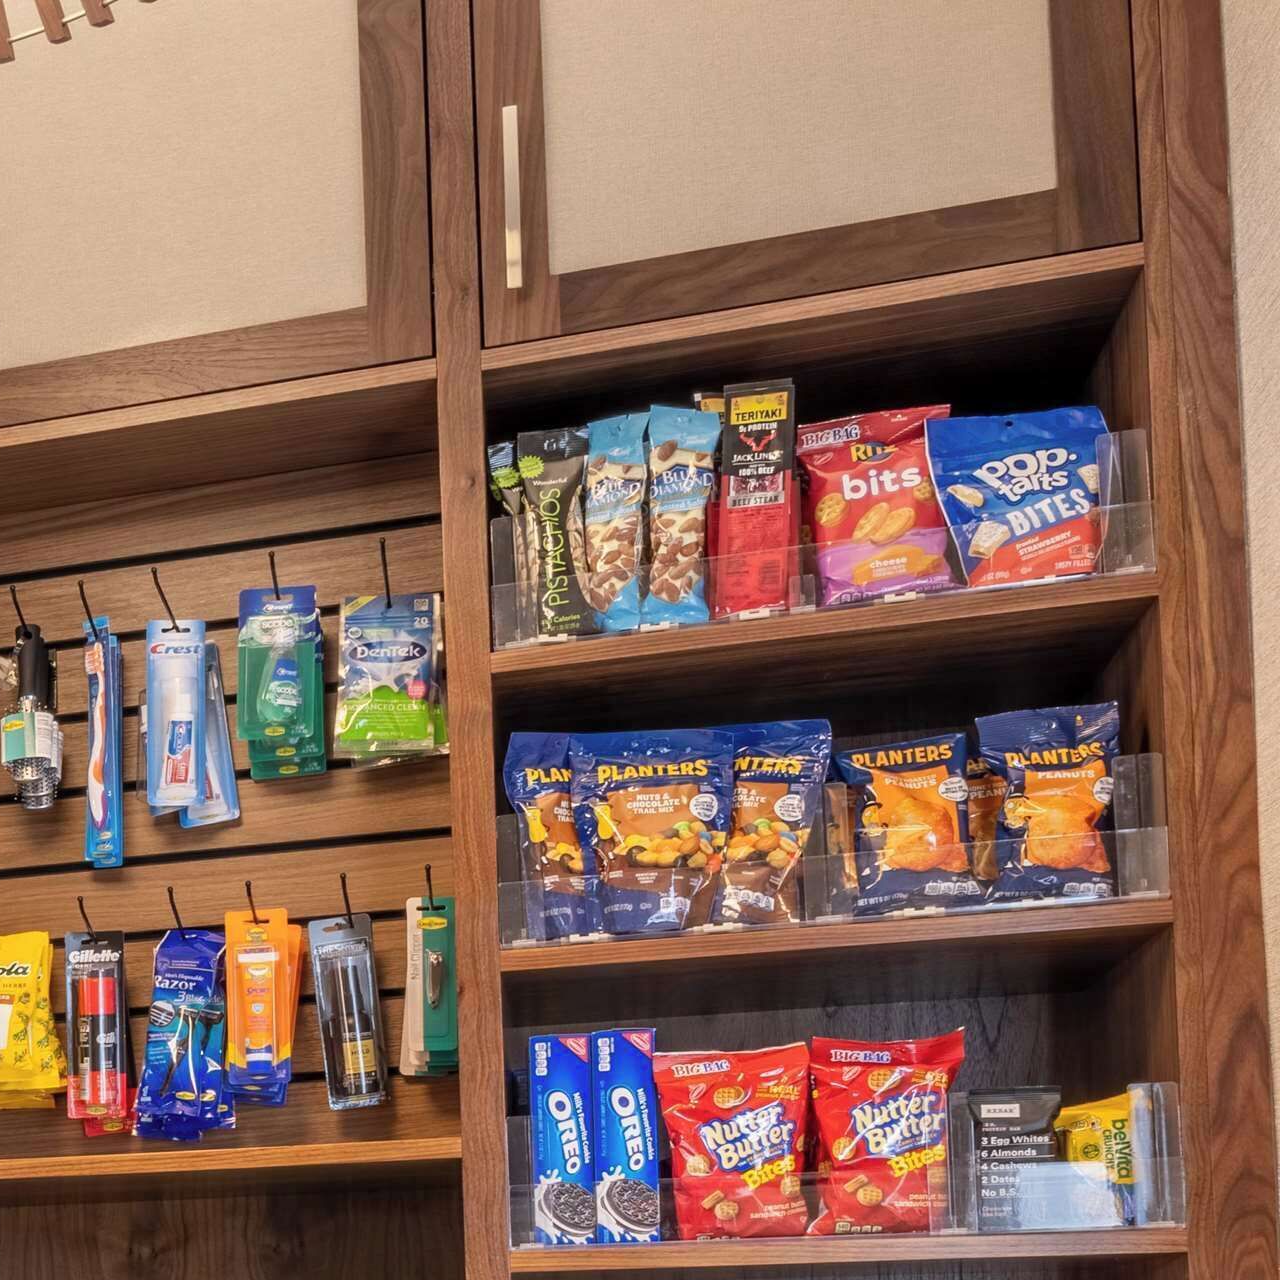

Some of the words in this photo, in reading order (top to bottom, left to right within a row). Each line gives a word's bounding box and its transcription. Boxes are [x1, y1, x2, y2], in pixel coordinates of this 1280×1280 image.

[736, 409, 782, 421] TERIYAKI
[803, 431, 830, 447] BIG
[831, 425, 860, 441] BAG
[842, 468, 922, 499] bits
[1007, 489, 1089, 536] BITES
[540, 488, 569, 607] PISTACHIOS
[414, 616, 428, 625] 20
[150, 643, 201, 655] Crest
[356, 646, 420, 658] DenTek
[851, 744, 952, 768] PLANTERS
[1004, 743, 1104, 767] PLANTERS
[598, 759, 708, 783] PLANTERS
[627, 797, 680, 809] CHOCOLATE
[636, 794, 659, 802] NUTS
[634, 806, 657, 814] TRAIL
[69, 950, 120, 963] Gillette
[154, 975, 195, 991] Razor
[672, 1063, 700, 1076] BIG
[703, 1060, 730, 1074] BAG
[547, 1090, 581, 1175] OREO
[611, 1086, 645, 1171] OREO
[702, 1104, 783, 1151] Nutter
[717, 1122, 794, 1171] Butter
[981, 1137, 988, 1145] 3
[991, 1137, 1009, 1145] Egg
[1012, 1135, 1049, 1144] Whites
[1112, 1119, 1131, 1179] belVita
[982, 1150, 988, 1158] 6
[991, 1149, 1036, 1157] Almonds
[742, 1156, 796, 1190] Bites
[982, 1189, 996, 1197] No
